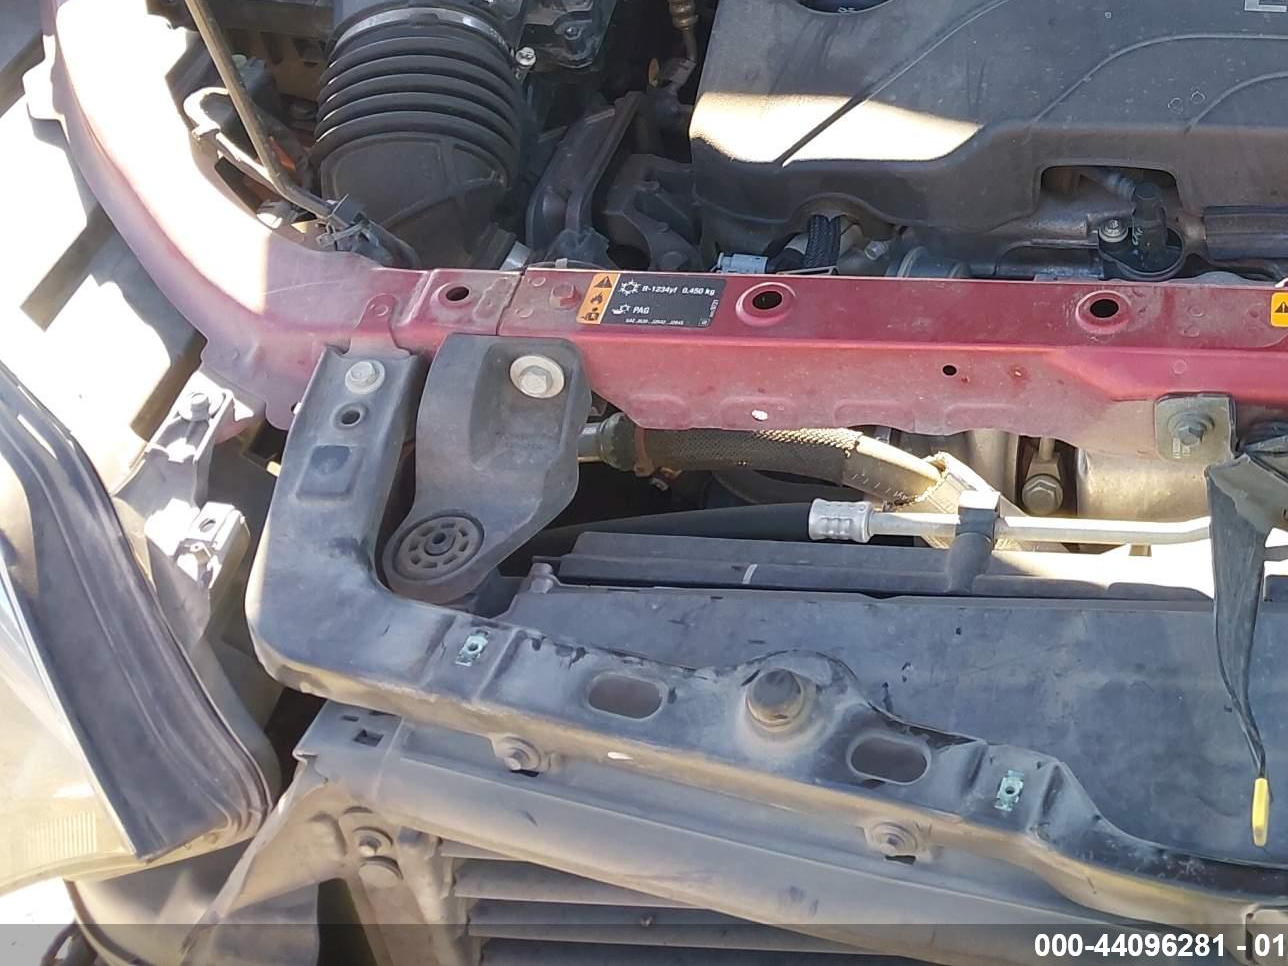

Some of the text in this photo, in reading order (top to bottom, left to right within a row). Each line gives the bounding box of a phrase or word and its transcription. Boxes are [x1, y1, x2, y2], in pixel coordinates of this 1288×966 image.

[642, 285, 716, 296] R-1234yf 0.450 kg
[632, 306, 650, 314] PAG
